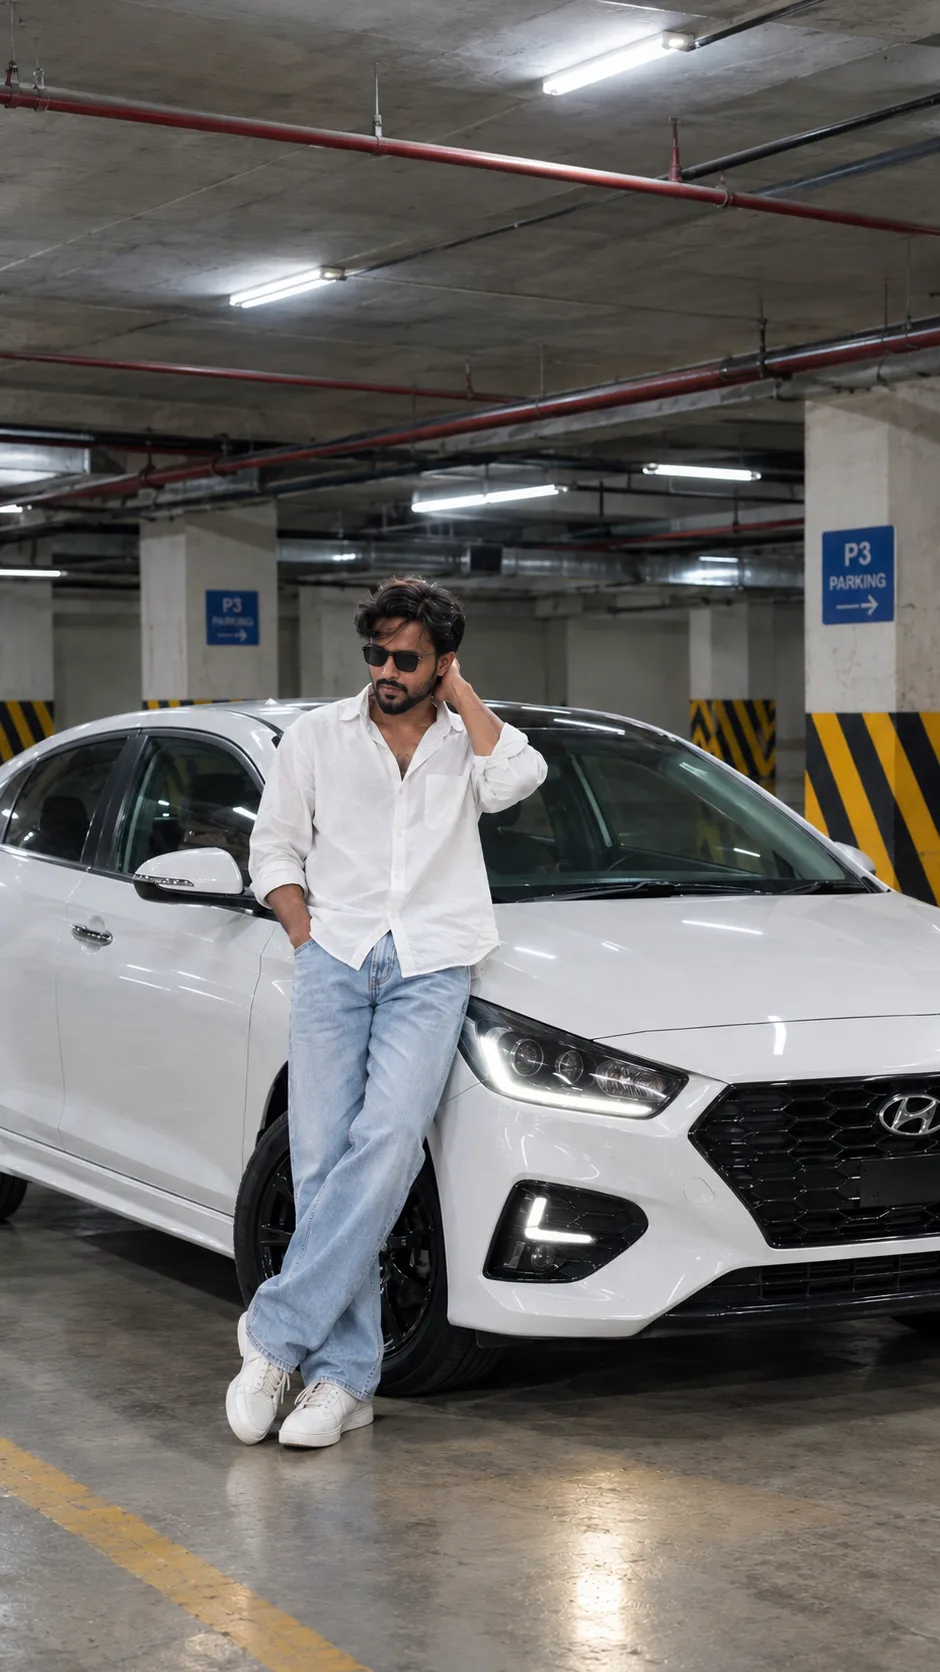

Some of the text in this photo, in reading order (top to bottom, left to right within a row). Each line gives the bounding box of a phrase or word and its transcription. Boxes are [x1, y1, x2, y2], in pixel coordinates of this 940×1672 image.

[844, 541, 872, 567] P3
[829, 572, 886, 591] PARKING
[222, 597, 243, 613] P3
